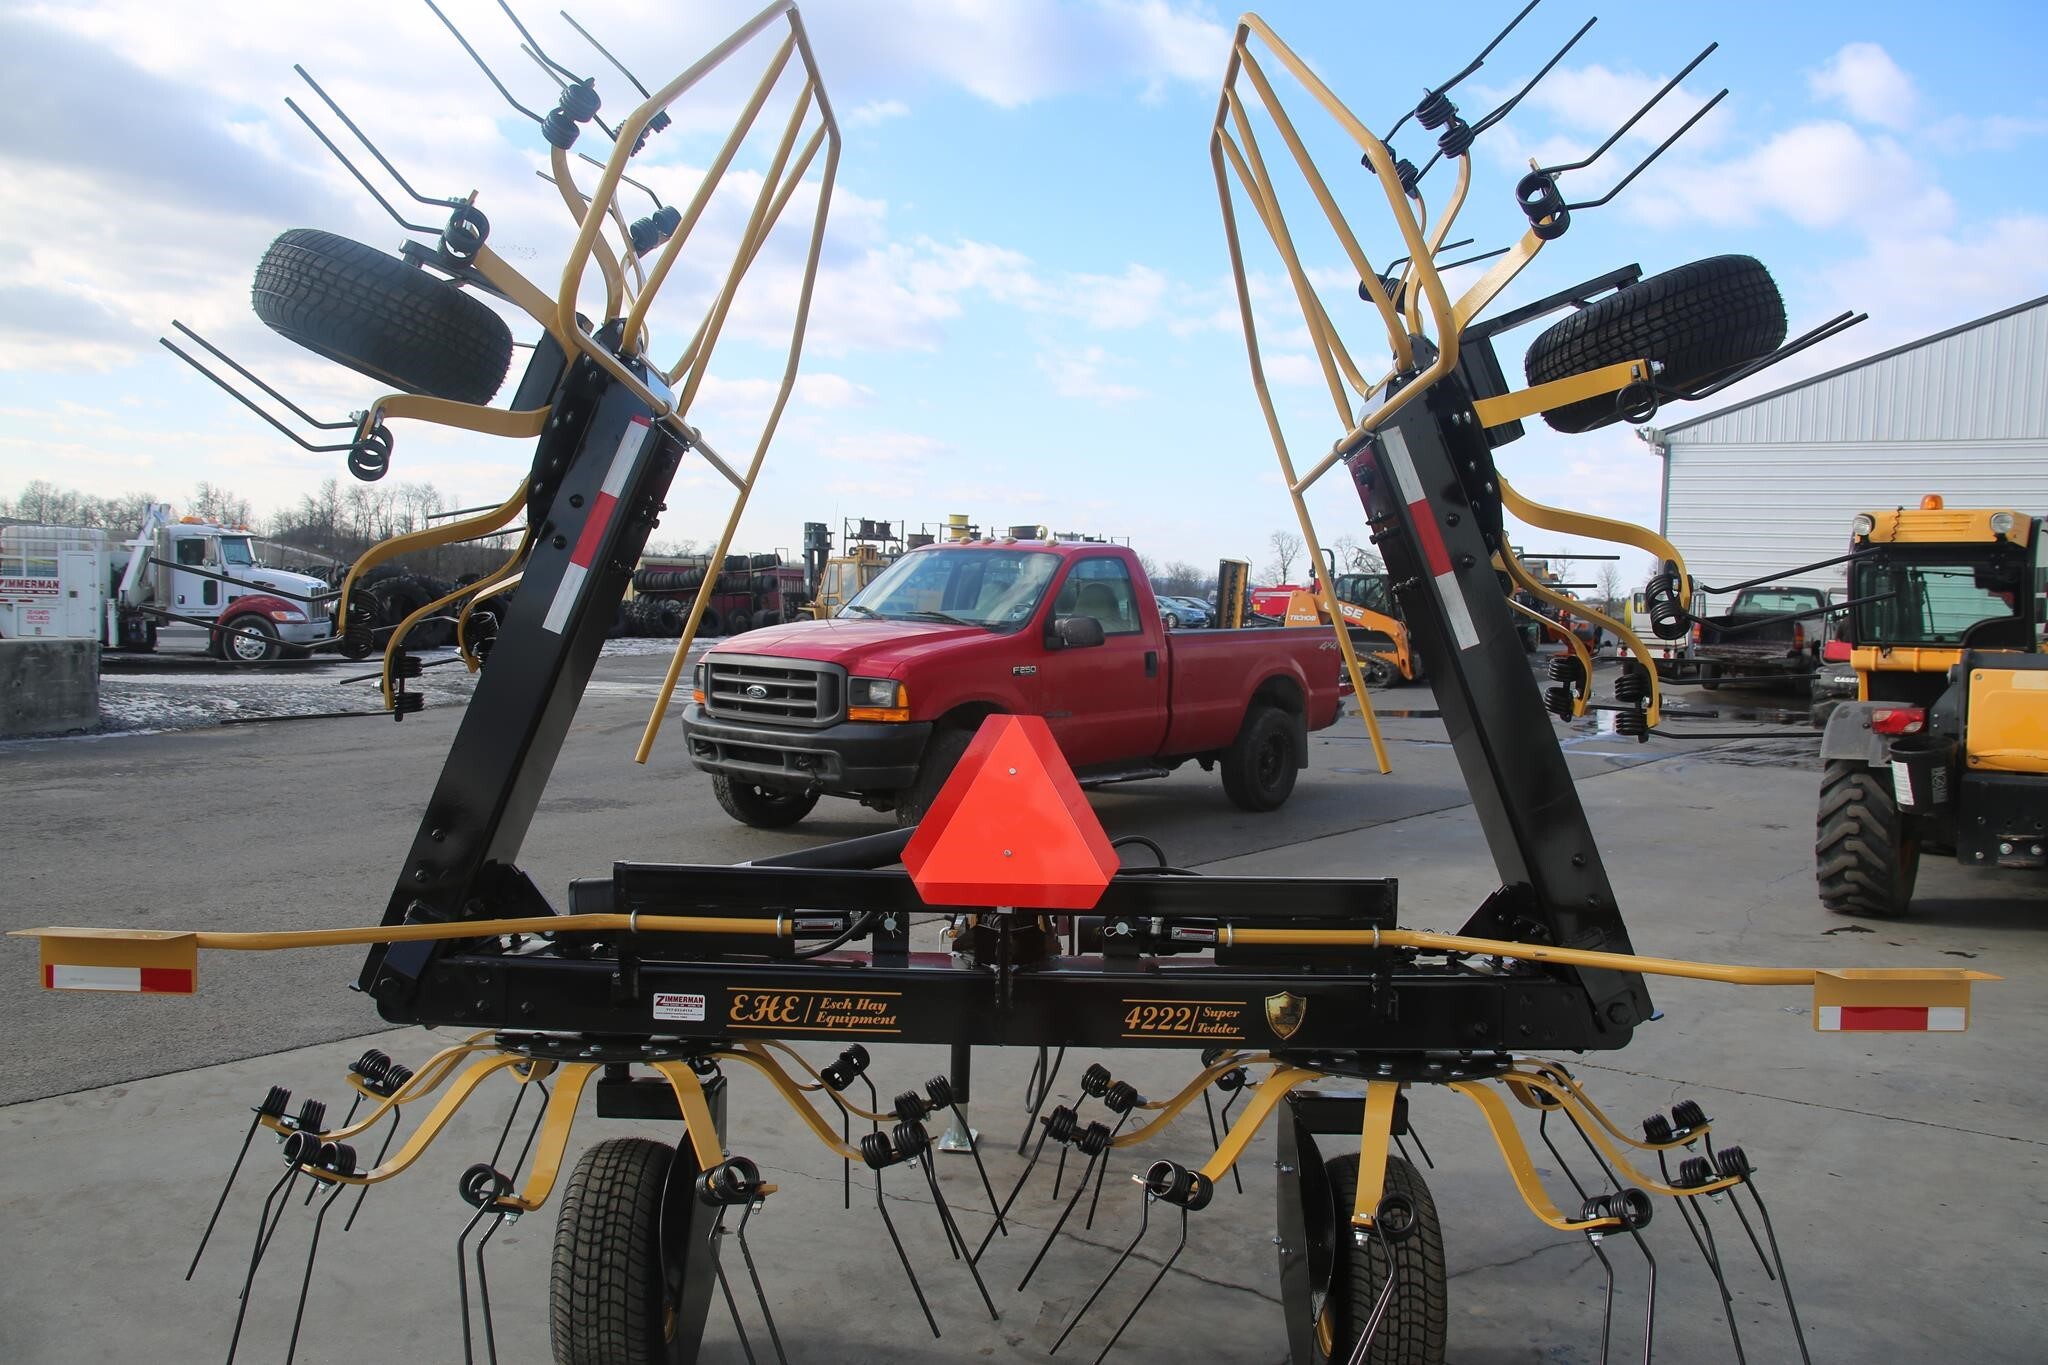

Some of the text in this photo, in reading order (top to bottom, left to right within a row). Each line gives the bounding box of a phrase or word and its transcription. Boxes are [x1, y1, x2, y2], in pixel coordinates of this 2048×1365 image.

[656, 995, 704, 1006] ZIMMERMAN
[730, 994, 801, 1023] EHE
[819, 997, 888, 1014] Esch Hay
[815, 1011, 897, 1027] Equipment
[1124, 1006, 1192, 1030] 4222
[1202, 1006, 1240, 1021] Super
[1197, 1022, 1240, 1034] Tedder
